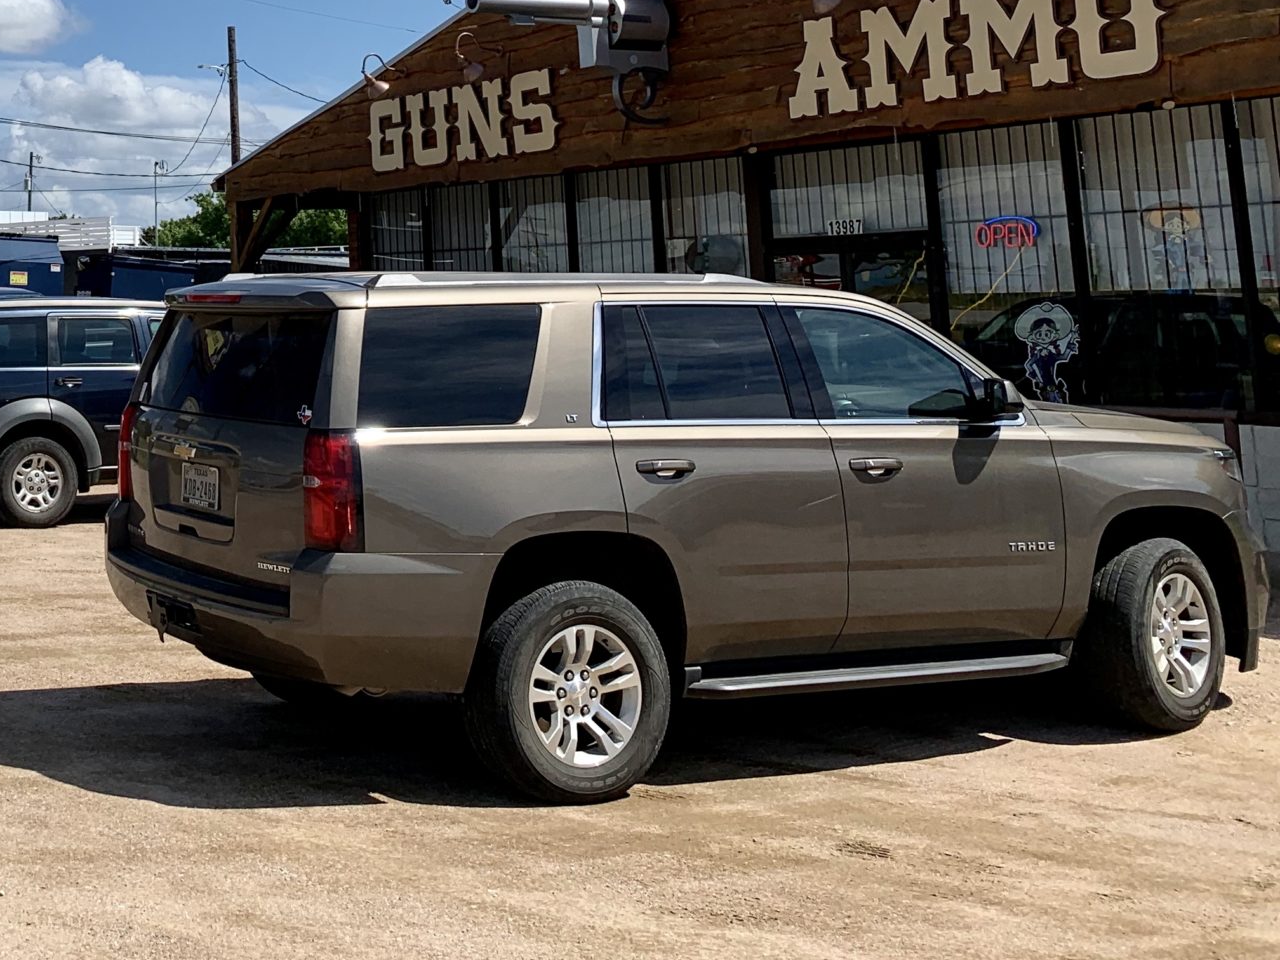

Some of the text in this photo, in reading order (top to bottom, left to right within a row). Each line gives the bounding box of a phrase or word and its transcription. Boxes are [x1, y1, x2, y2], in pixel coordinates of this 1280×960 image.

[367, 67, 562, 173] GUNS
[828, 219, 862, 235] 13987
[975, 223, 1034, 248] OPEN
[194, 467, 209, 478] TEXAS
[1008, 541, 1056, 552] TAHOE
[257, 562, 291, 574] HEWLETT
